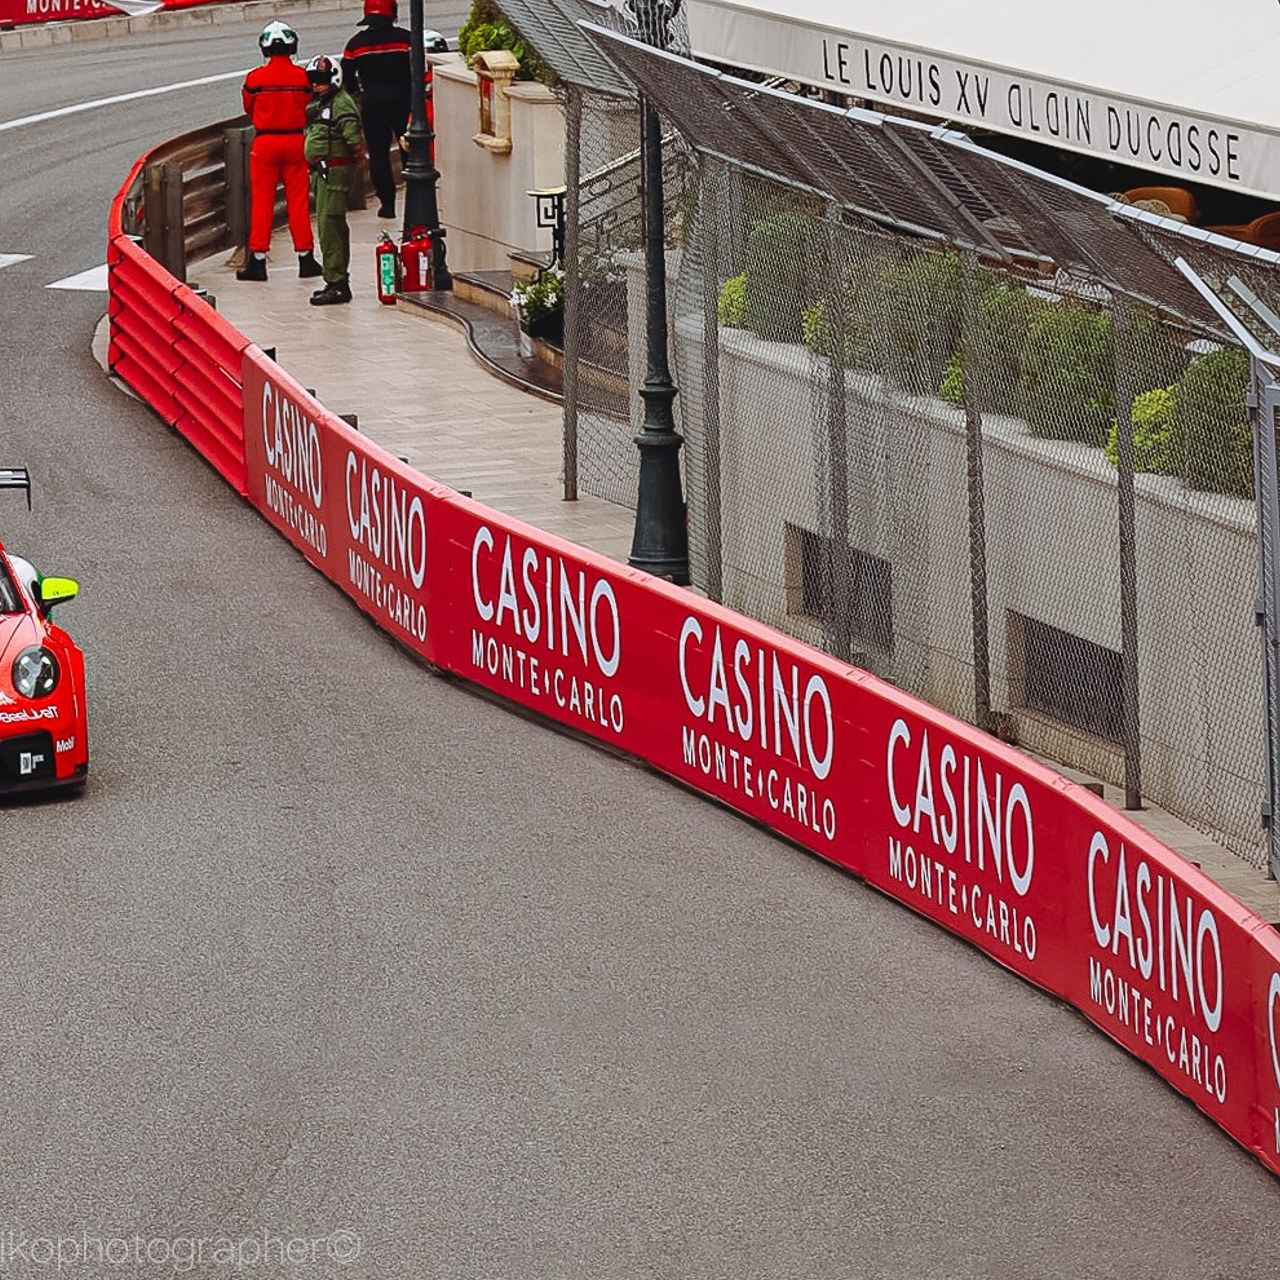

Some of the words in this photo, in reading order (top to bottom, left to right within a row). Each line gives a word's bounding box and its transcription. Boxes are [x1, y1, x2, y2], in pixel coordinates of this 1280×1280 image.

[821, 37, 851, 85] LE
[864, 48, 942, 106] LOUIS
[955, 69, 990, 118] XV
[262, 379, 323, 509] CASINO
[345, 449, 428, 589] CASINO
[471, 525, 621, 678] CASINO
[678, 616, 835, 781] CASINO
[886, 718, 1035, 897] CASINO
[1087, 831, 1224, 1033] CASINO
